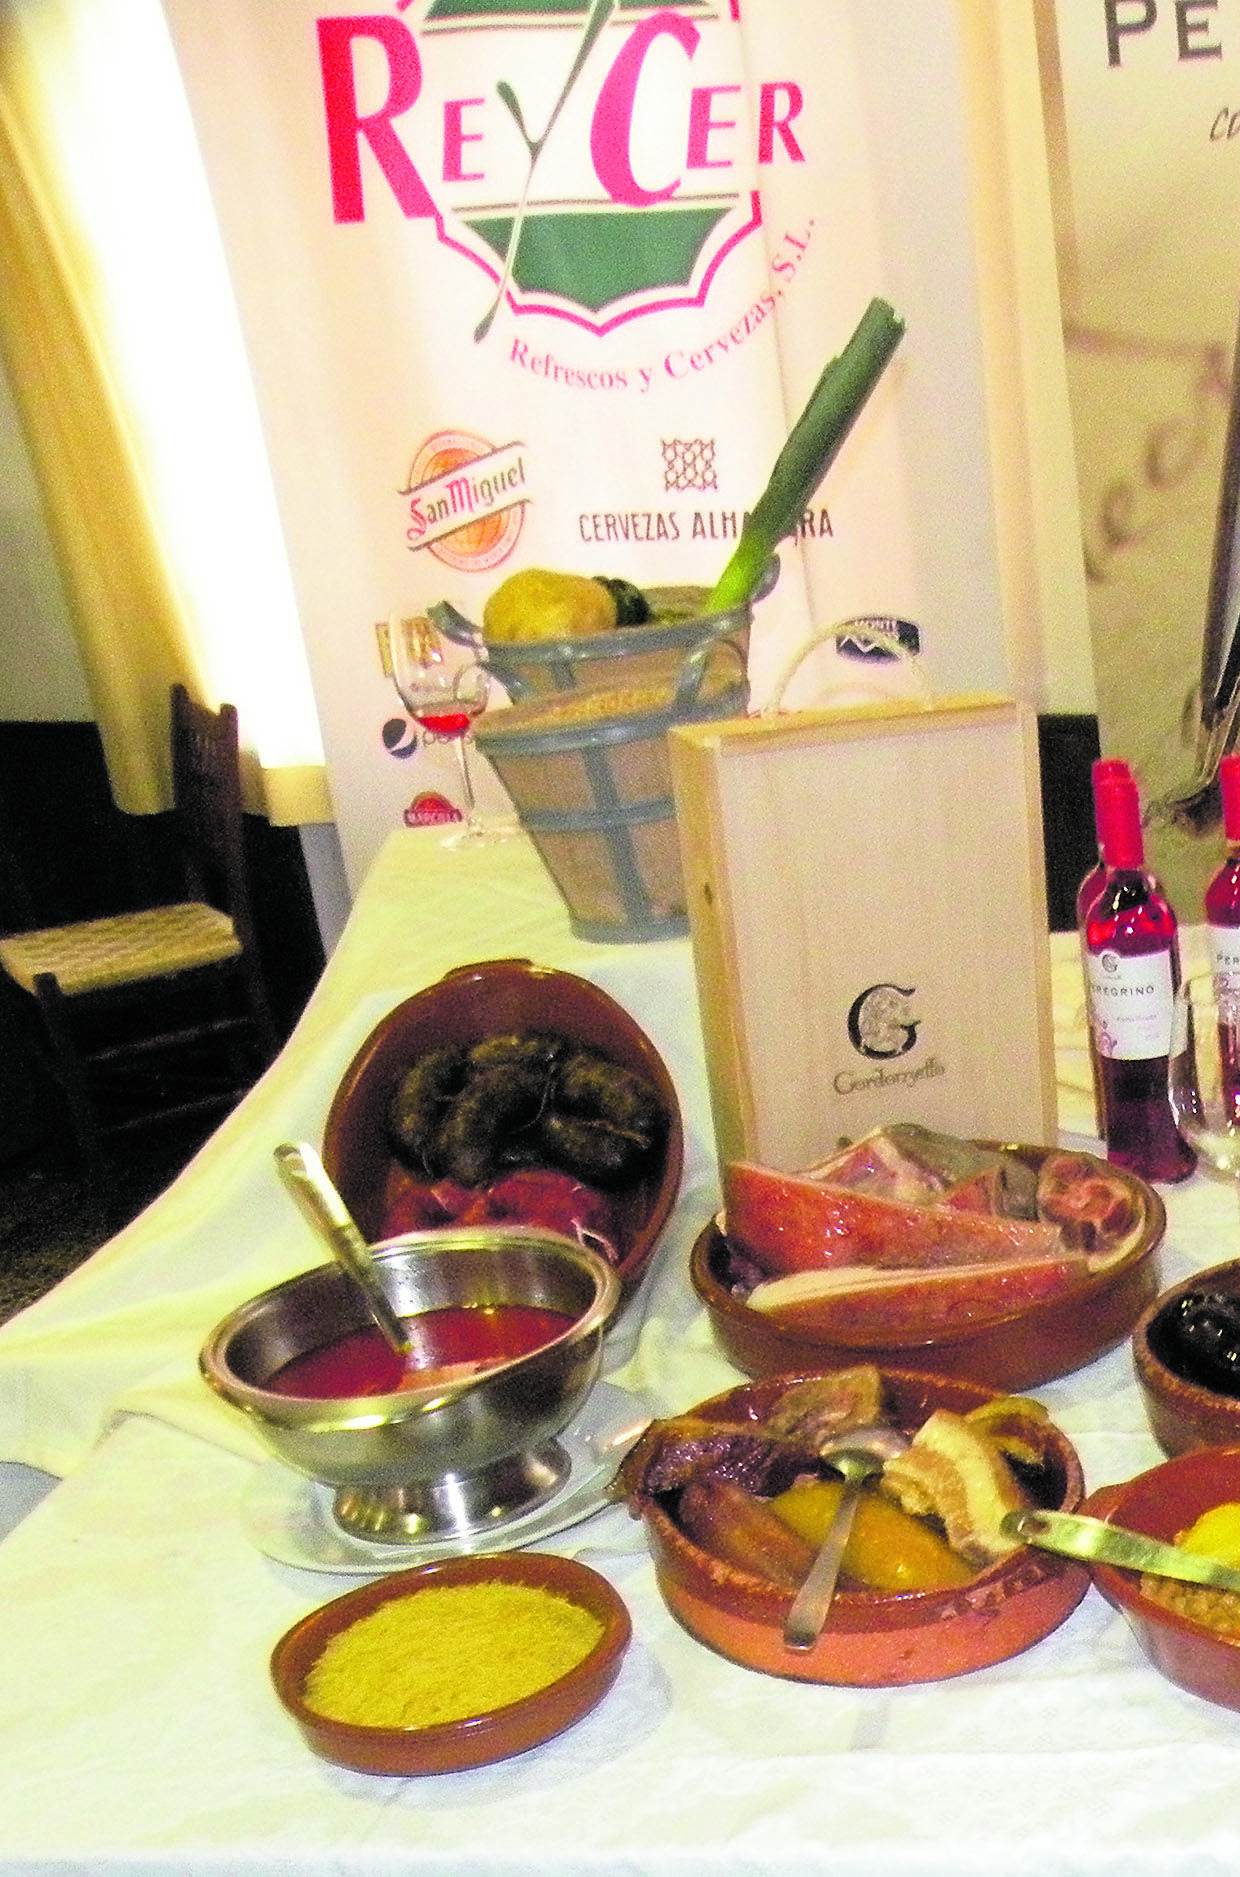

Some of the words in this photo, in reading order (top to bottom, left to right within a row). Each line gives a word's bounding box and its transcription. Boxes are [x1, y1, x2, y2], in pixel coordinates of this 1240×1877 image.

[509, 337, 628, 390] Refrescos
[638, 366, 653, 393] y
[579, 512, 681, 542] CERVEZAS
[691, 509, 834, 540] ALHRA
